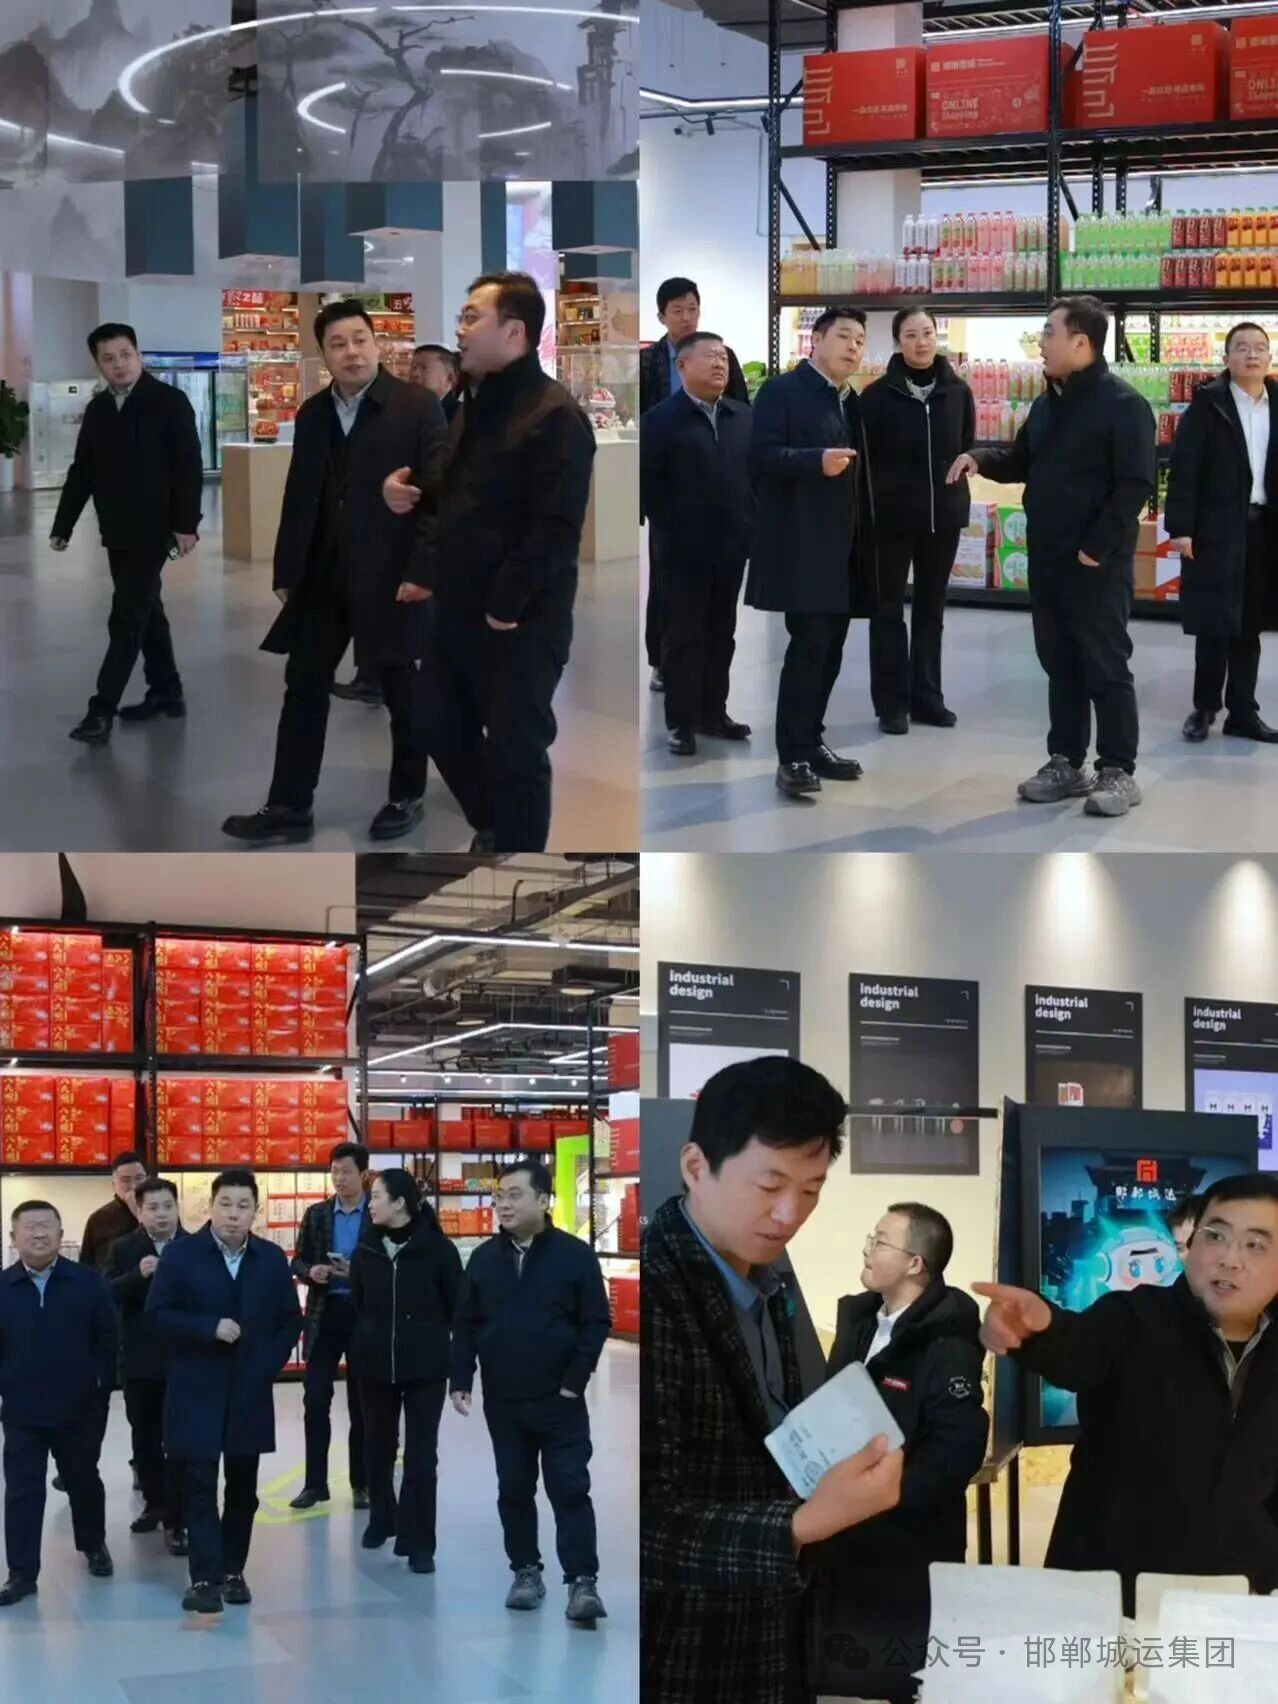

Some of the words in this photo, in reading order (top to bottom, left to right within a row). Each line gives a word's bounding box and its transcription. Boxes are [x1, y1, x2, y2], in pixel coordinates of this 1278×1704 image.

[669, 984, 713, 1000] design
[860, 996, 900, 1012] design
[1035, 1007, 1071, 1021] design
[1193, 1018, 1227, 1032] design
